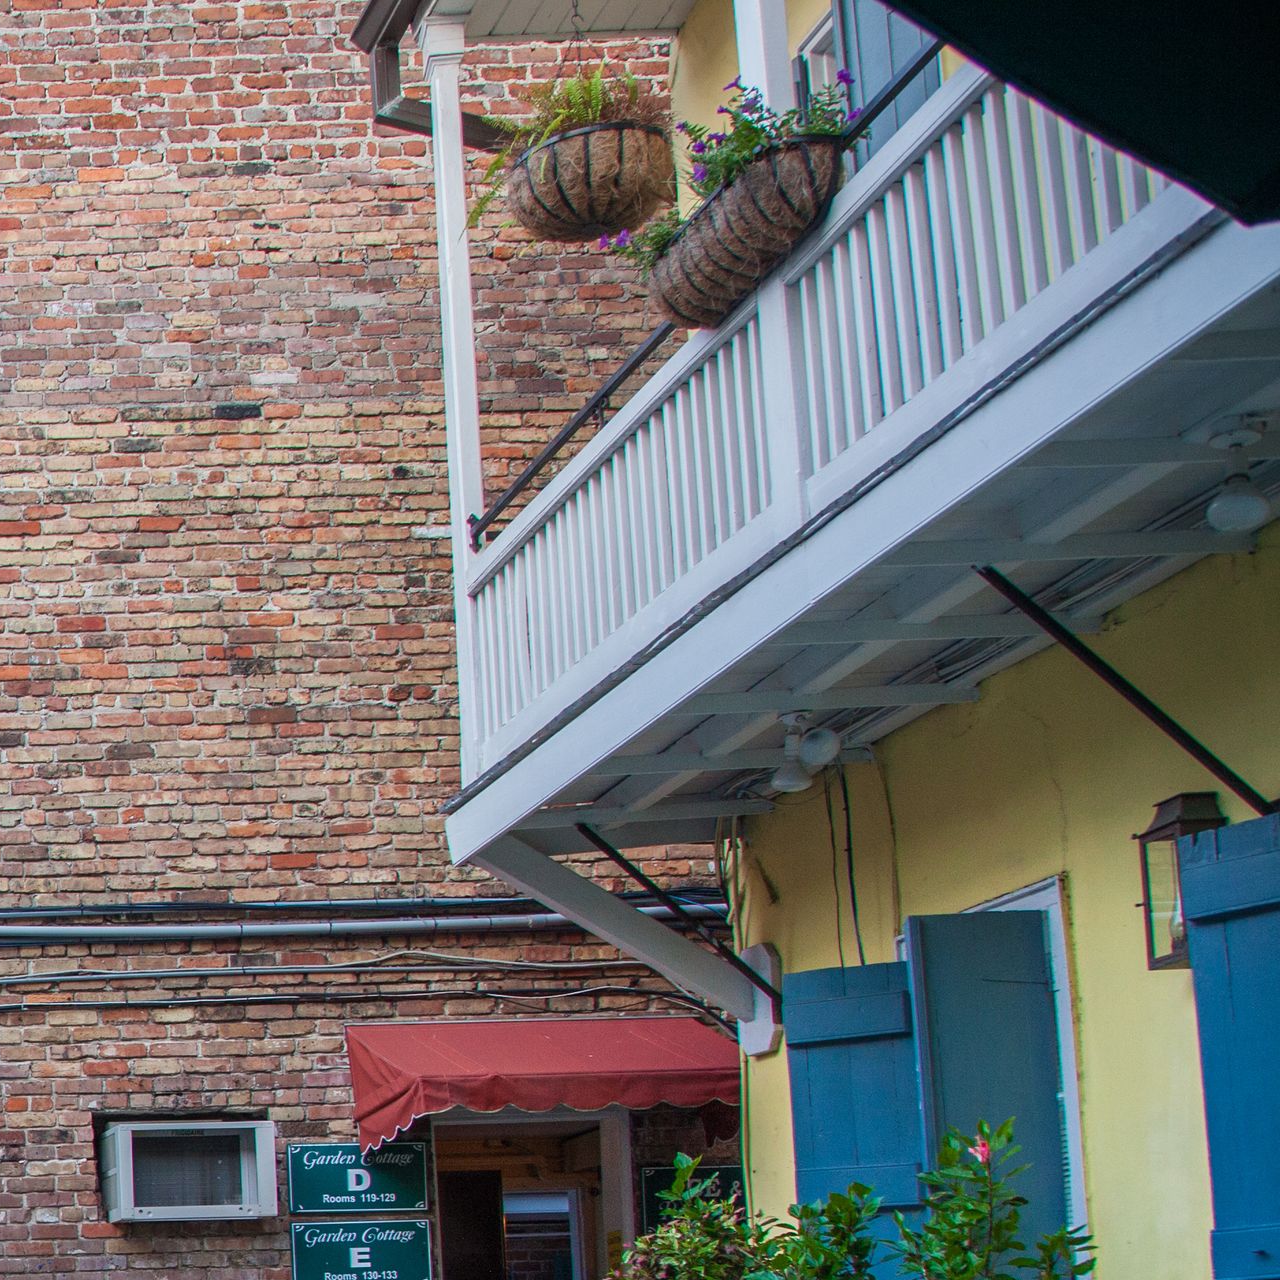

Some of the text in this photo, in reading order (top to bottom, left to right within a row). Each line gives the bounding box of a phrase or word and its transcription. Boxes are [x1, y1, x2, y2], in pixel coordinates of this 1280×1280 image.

[303, 1150, 415, 1170] Garden Cottage
[347, 1168, 372, 1192] D
[322, 1193, 396, 1204] Rooms 119-129
[305, 1227, 416, 1248] Garden Cottage
[349, 1247, 372, 1269] E
[361, 1270, 398, 1280] 130-133
